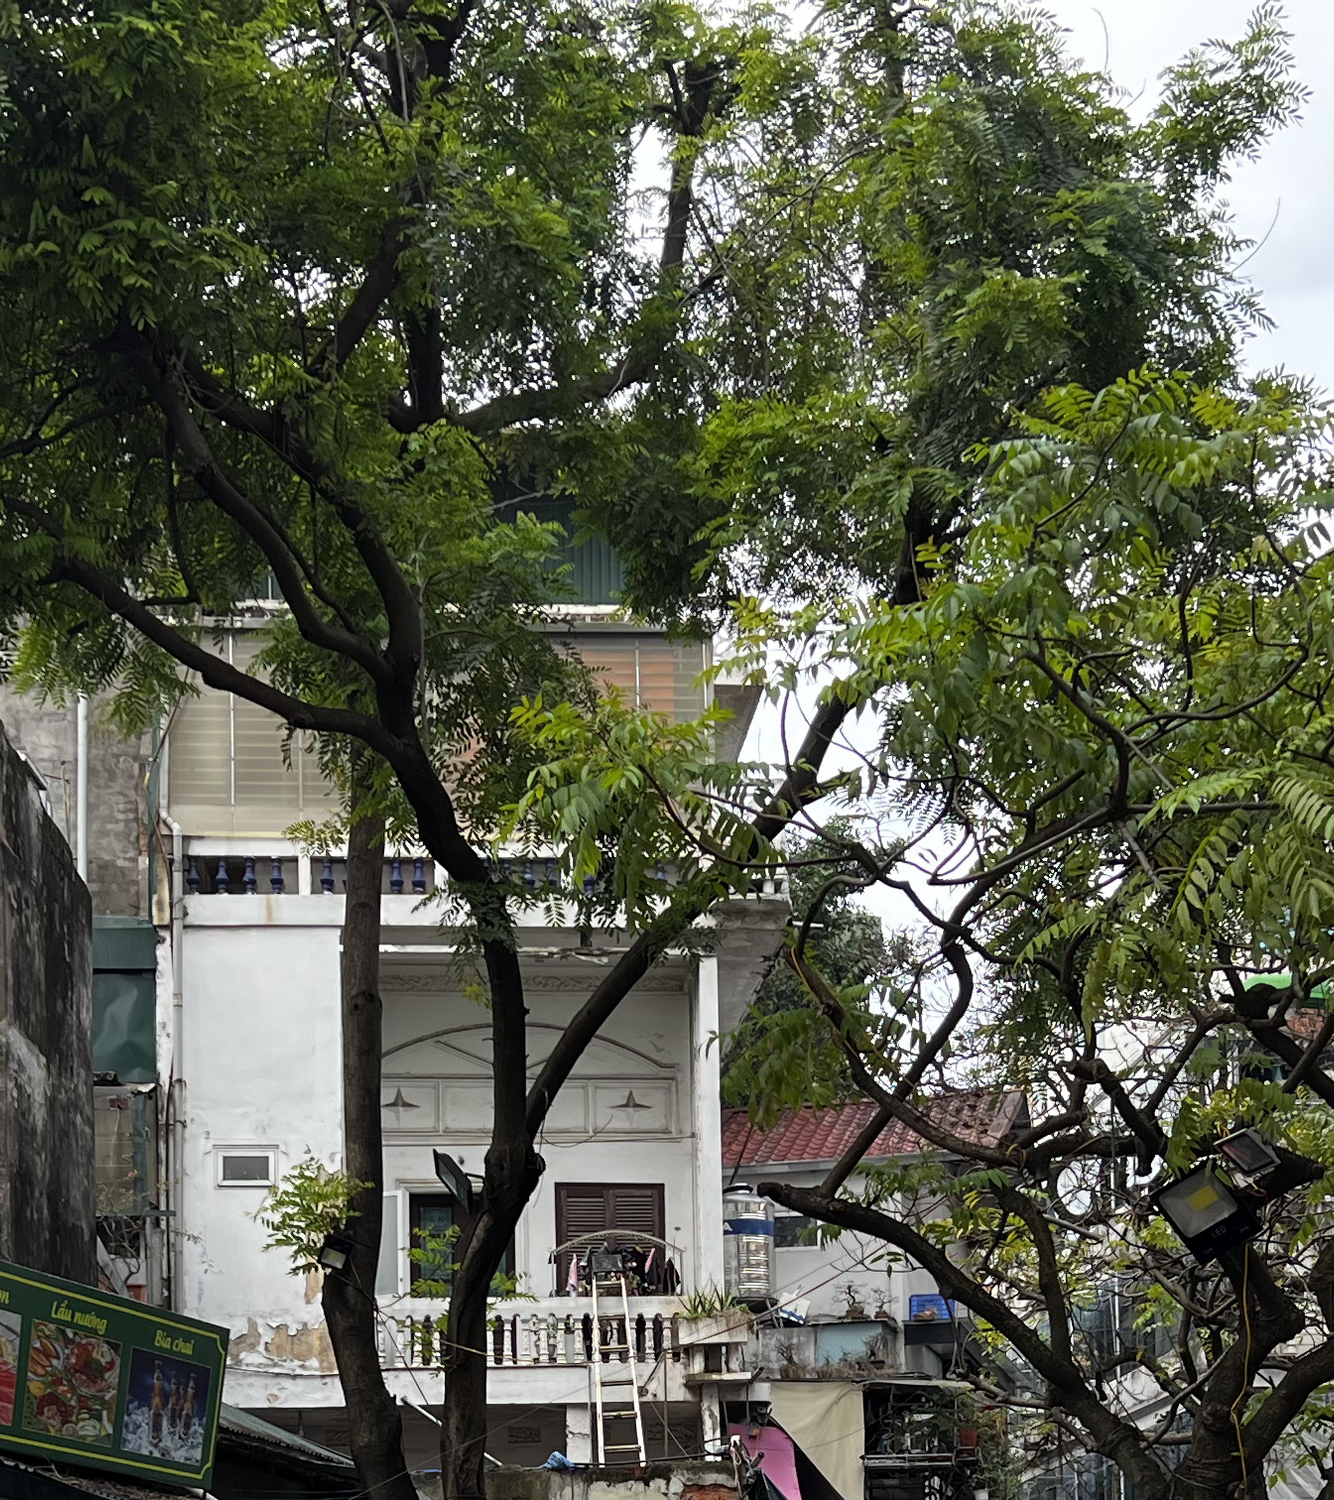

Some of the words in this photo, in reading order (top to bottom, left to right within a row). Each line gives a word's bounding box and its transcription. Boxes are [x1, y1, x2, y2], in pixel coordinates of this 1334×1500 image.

[51, 1299, 73, 1322] Lẩu
[74, 1311, 108, 1335] nướng
[155, 1330, 172, 1349] Bia
